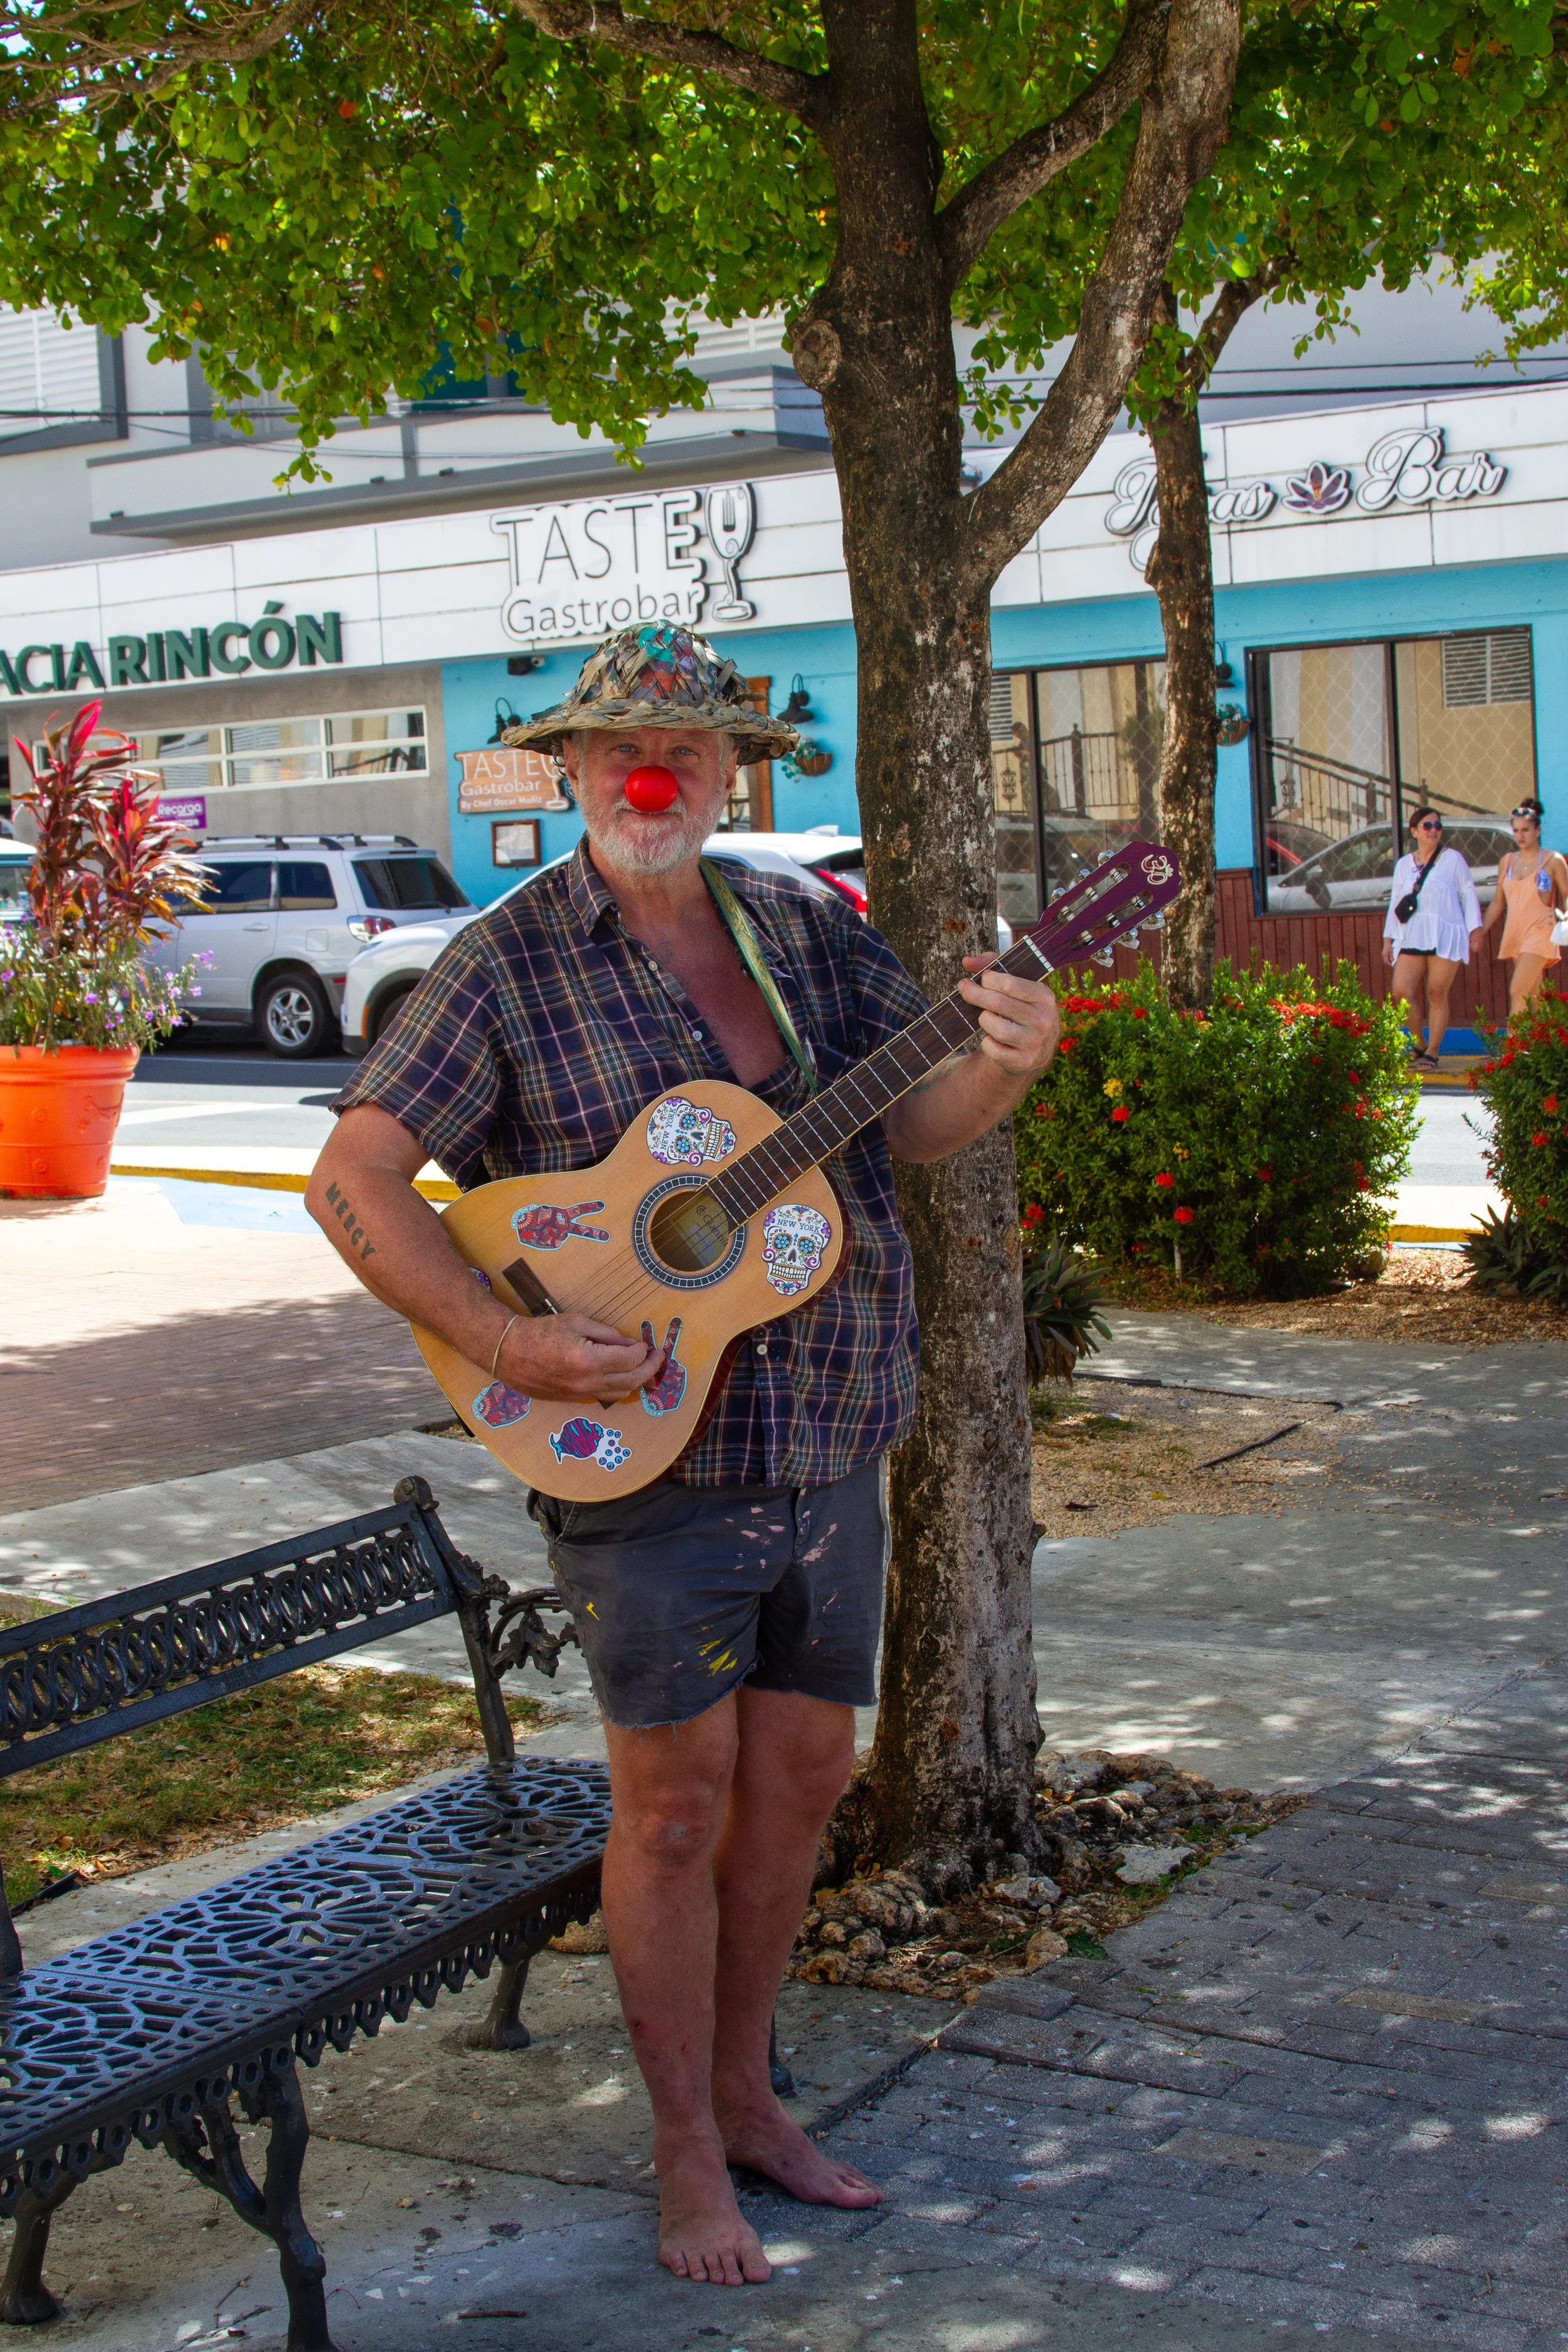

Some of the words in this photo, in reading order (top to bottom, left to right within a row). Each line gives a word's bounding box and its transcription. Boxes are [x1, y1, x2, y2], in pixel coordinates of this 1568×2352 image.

[1359, 427, 1505, 509] Bar
[495, 498, 696, 586] TASTE
[507, 583, 699, 633] Gastrobar
[108, 600, 343, 686] RINCÓN
[455, 750, 540, 780] TASTE
[460, 778, 541, 797] Gastrobar
[157, 803, 203, 817] Recarga
[660, 1130, 670, 1150] NEW
[665, 1107, 676, 1128] YORK
[522, 1204, 537, 1213] NEW
[777, 1219, 797, 1228] NEW
[799, 1222, 820, 1233] YORK
[646, 1407, 661, 1416] YORK
